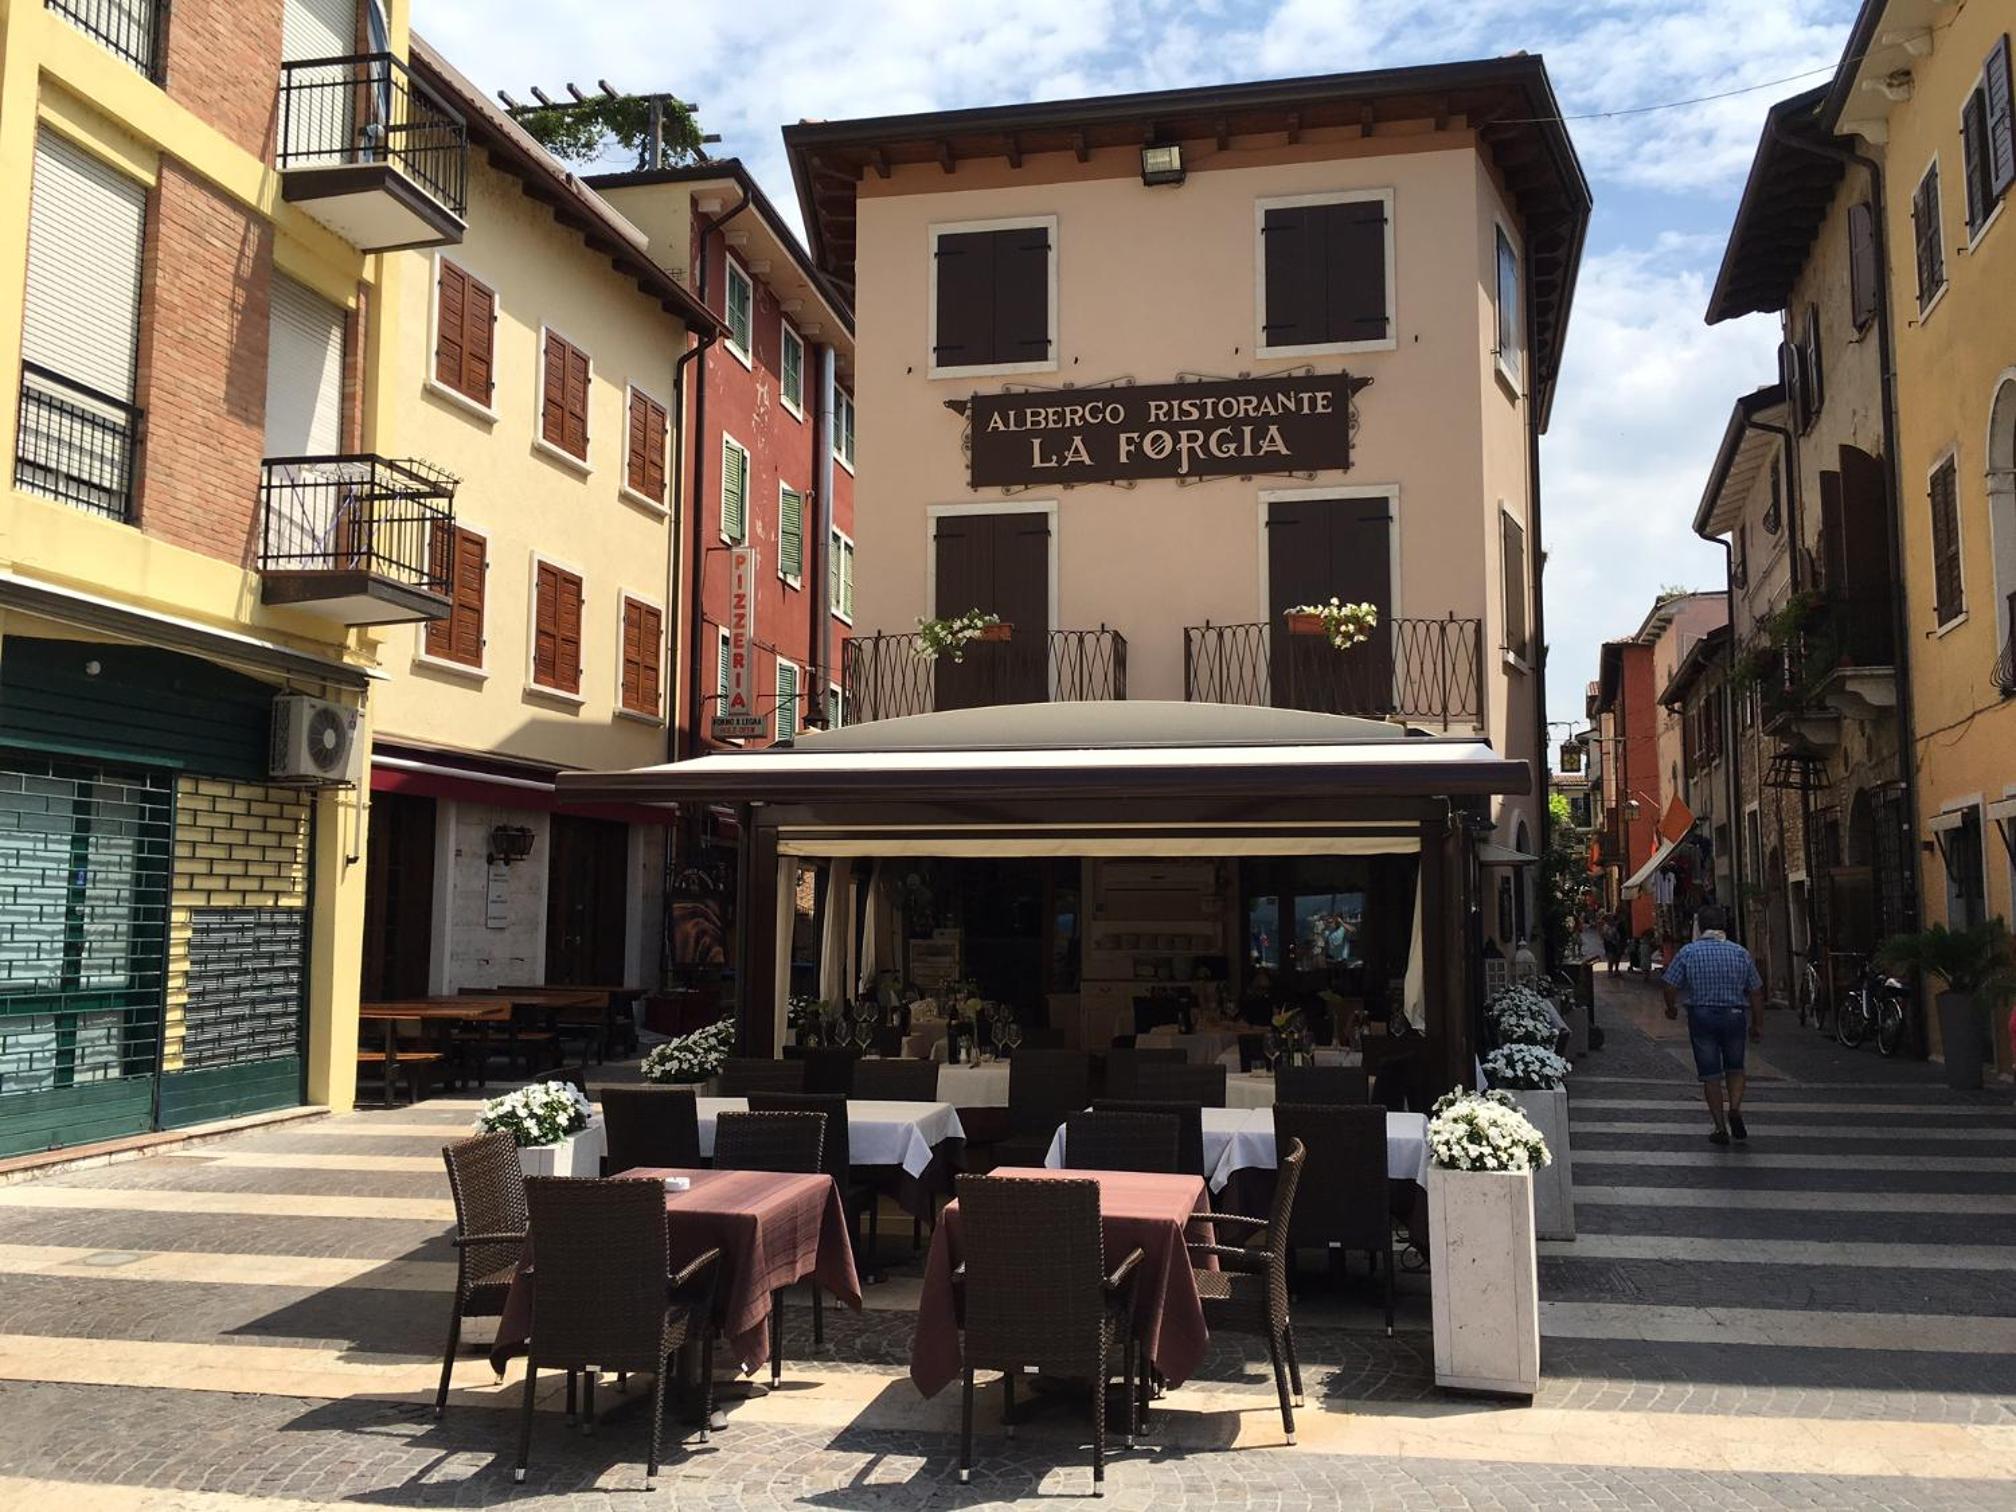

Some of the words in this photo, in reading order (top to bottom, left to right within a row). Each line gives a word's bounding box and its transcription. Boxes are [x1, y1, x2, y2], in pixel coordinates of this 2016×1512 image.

[986, 401, 1125, 432] ALBERGO
[1148, 391, 1332, 422] RISTORANTE
[1030, 435, 1094, 468] LA
[1118, 425, 1292, 474] FORGIA
[731, 554, 746, 708] PIZZERIA
